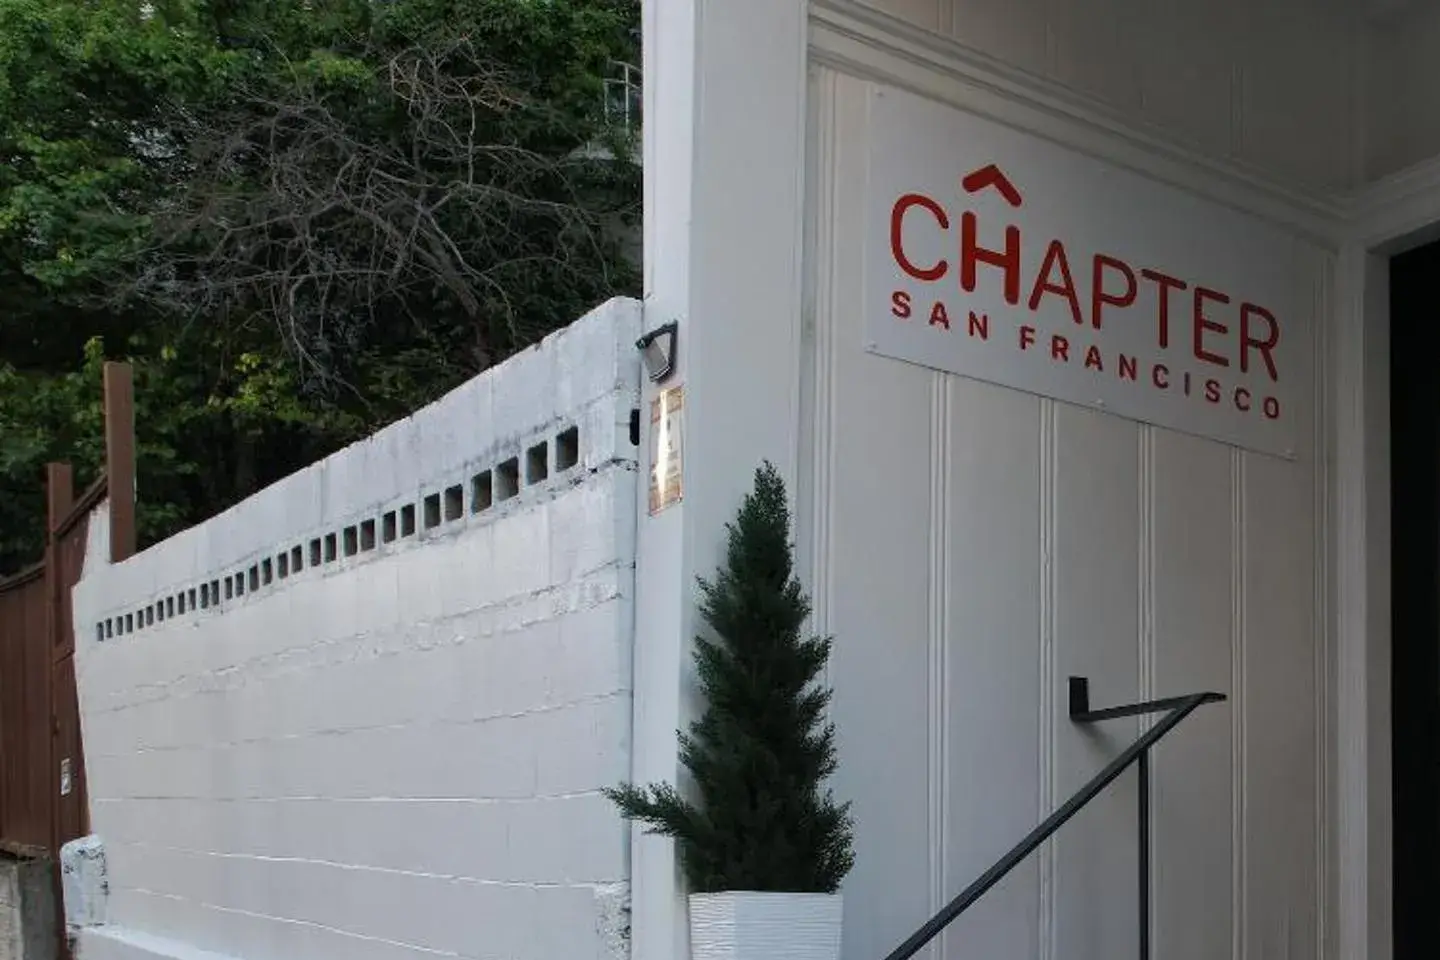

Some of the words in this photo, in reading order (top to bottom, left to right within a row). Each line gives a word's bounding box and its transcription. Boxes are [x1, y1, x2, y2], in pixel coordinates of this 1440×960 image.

[889, 192, 1282, 382] CHAPTER
[890, 290, 989, 341] SAN
[1018, 325, 1282, 420] FRANCISCO
